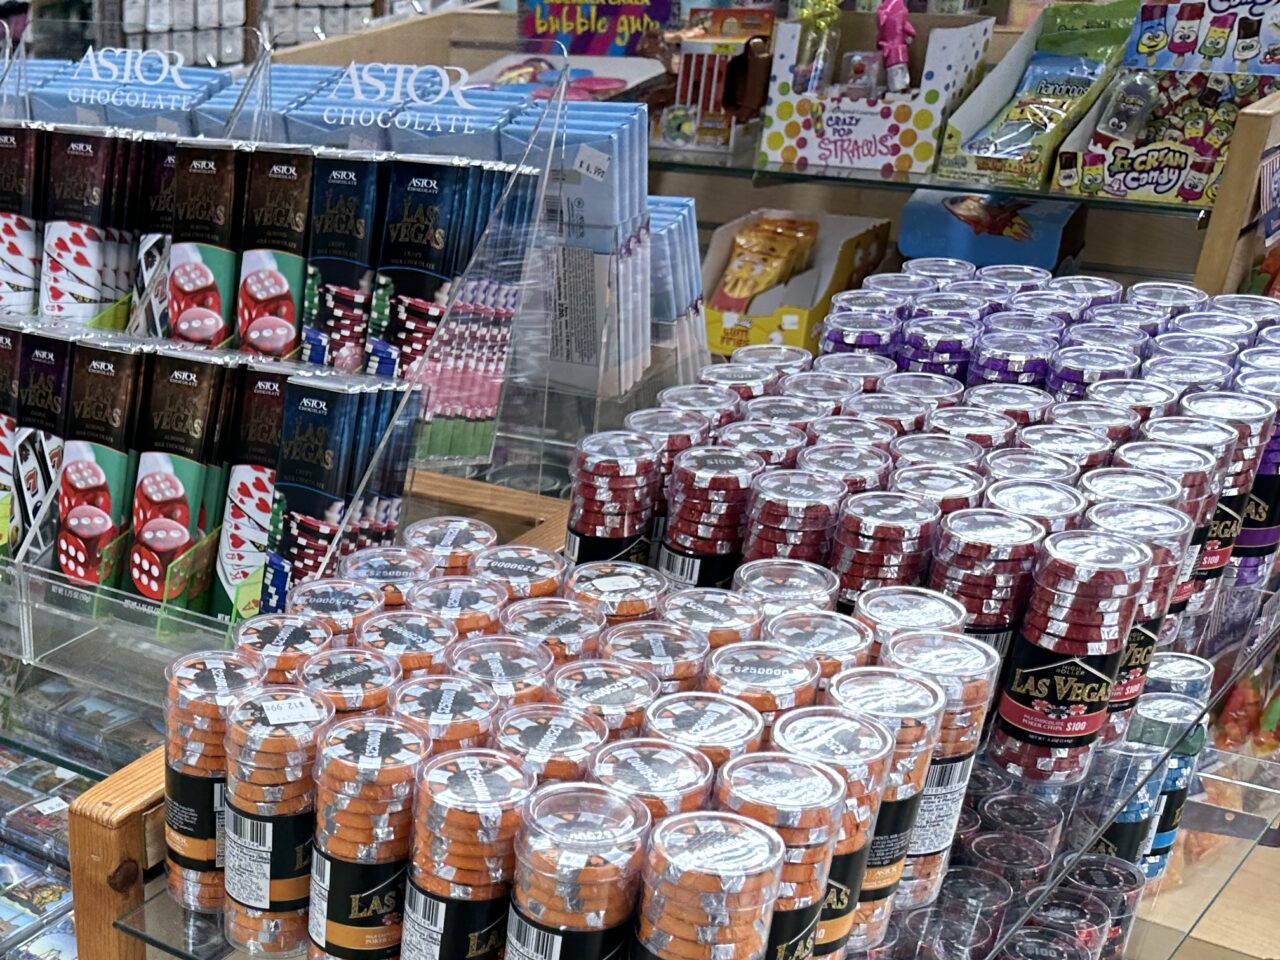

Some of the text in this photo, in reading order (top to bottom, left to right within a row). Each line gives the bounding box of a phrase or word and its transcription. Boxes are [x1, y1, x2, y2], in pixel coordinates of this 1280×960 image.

[535, 5, 660, 46] bubble gum
[71, 45, 194, 90] ASTOR
[328, 60, 479, 110] ASTOR
[67, 87, 194, 112] CHOCOLATE
[323, 107, 476, 135] CHOCOLATE
[826, 116, 860, 127] CRAZY
[832, 128, 853, 137] POP
[69, 142, 93, 153] ASTOR
[818, 135, 893, 165] STRAWS
[190, 160, 216, 170] ASTOR
[270, 165, 297, 176] ASTOR
[329, 170, 357, 181] ASTOR
[408, 177, 438, 189] ASTOR
[314, 213, 365, 240] VEGAS
[389, 221, 445, 250] VEGAS
[32, 349, 55, 361] ASTOR
[89, 360, 115, 372] ASTOR
[171, 370, 198, 383] ASTOR
[255, 380, 279, 392] ASTOR
[20, 388, 62, 415] VEGAS
[300, 397, 328, 411] ASTOR
[73, 400, 122, 428] VEGAS
[152, 411, 204, 440] VEGAS
[707, 457, 736, 466] $100
[1010, 668, 1051, 698] LAS
[1124, 684, 1141, 695] $100
[1066, 721, 1087, 732] $100
[349, 891, 397, 919] LAS
